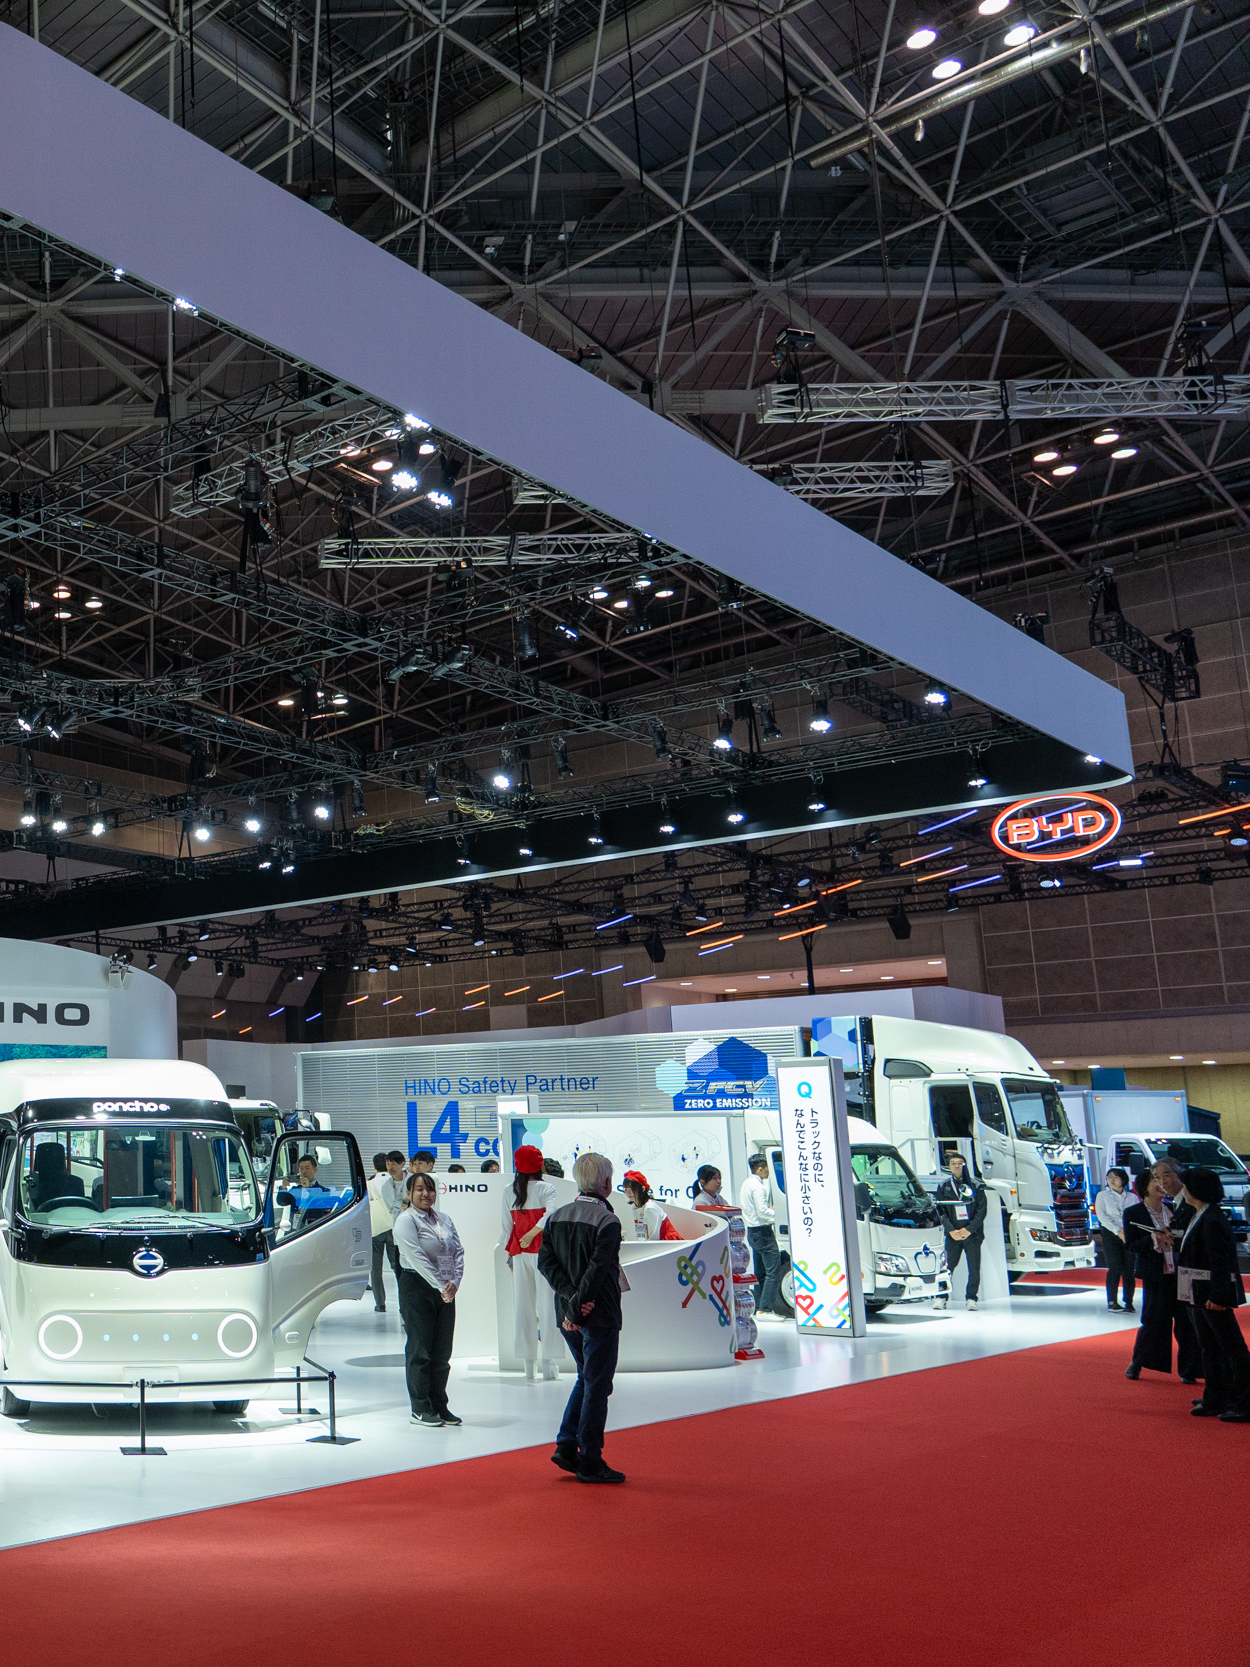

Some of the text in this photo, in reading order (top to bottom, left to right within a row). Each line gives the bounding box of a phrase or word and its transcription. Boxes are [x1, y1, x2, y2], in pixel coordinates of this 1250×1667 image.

[1006, 809, 1106, 845] BYD
[405, 1074, 599, 1096] HINO Safety Partner
[797, 1081, 813, 1099] Q
[93, 1100, 158, 1113] poncho
[684, 1098, 771, 1109] ZERO EMISSION
[406, 1100, 469, 1159] L4
[810, 1107, 825, 1188] トラックなのに、
[449, 1184, 488, 1193] HINO
[659, 1185, 680, 1198] for
